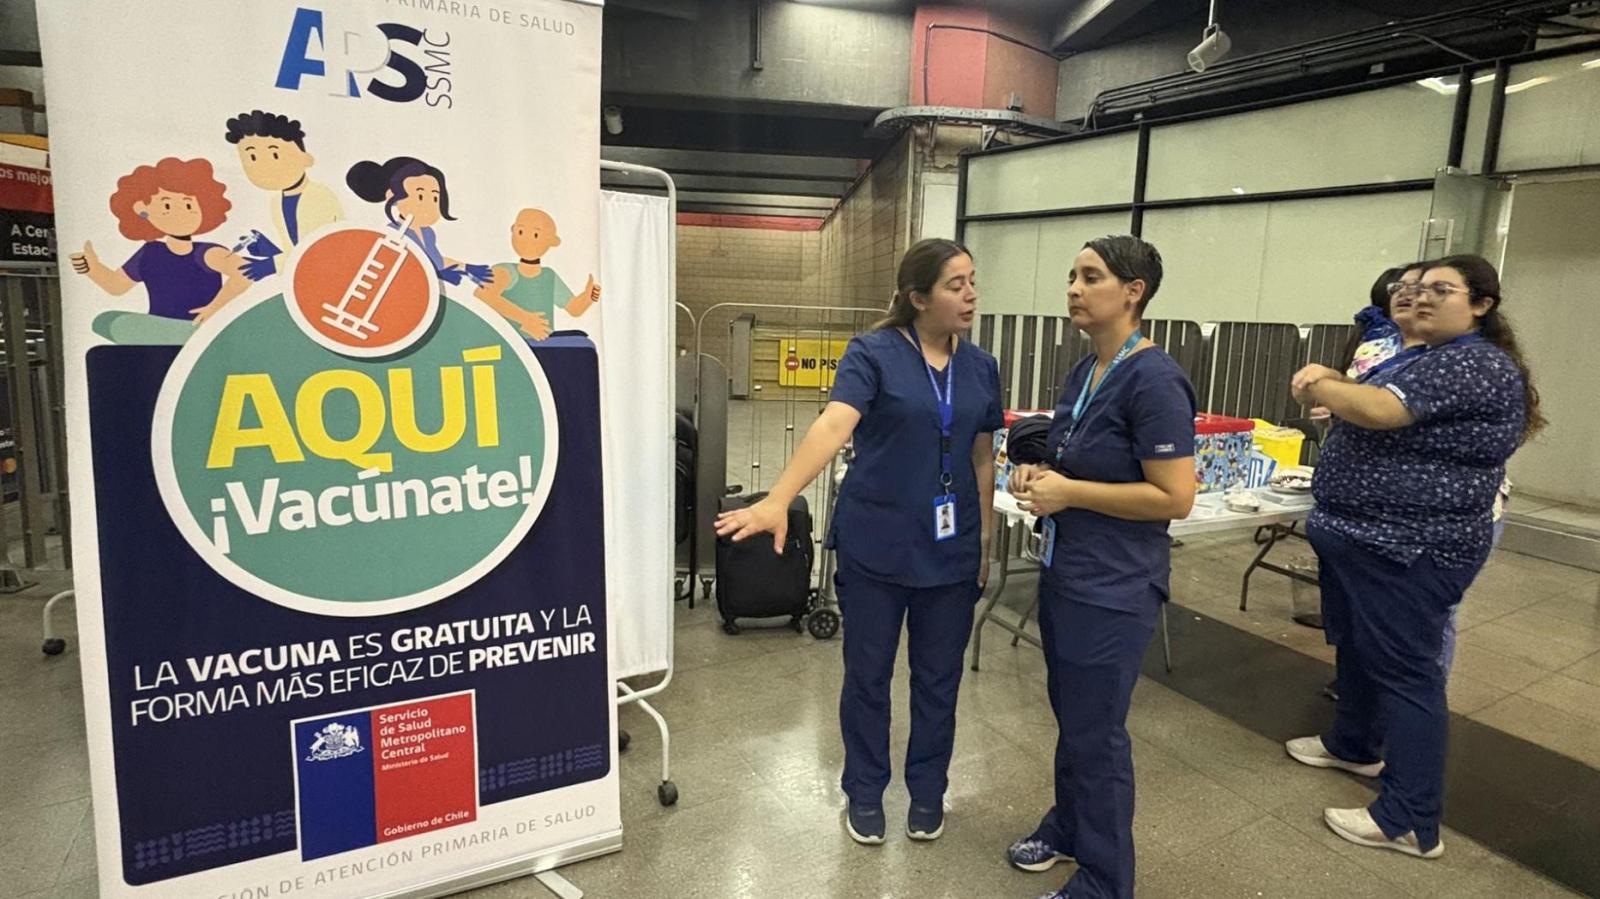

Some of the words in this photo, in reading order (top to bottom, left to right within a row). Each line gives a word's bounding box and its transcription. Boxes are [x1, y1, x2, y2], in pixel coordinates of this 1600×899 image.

[489, 8, 513, 25] DE
[520, 14, 576, 37] SALUD
[274, 7, 428, 103] APS
[423, 28, 452, 109] SSMC
[11, 223, 22, 237] A
[801, 358, 817, 370] NO
[206, 345, 502, 472] AQUÍ
[210, 456, 533, 554] ¡Vacúnate!
[134, 661, 179, 691] LA
[186, 639, 341, 682] VACUNA
[348, 632, 383, 660] ES
[390, 612, 535, 653] GRATUITA
[540, 608, 556, 631] Y
[563, 604, 592, 629] LA
[131, 684, 250, 726] FORMA
[256, 671, 324, 706] MÁS
[330, 657, 424, 694] EFICAZ
[429, 651, 464, 678] DE
[469, 631, 596, 672] PREVENIR
[379, 708, 429, 725] Servicio
[380, 726, 395, 737] de
[398, 718, 432, 733] Salud
[380, 725, 466, 749] Metropolitano
[381, 743, 426, 760] Central
[381, 759, 419, 771] Ministerio
[419, 756, 429, 764] de
[429, 752, 450, 762] Salud
[383, 819, 430, 837] Gobierno
[430, 816, 444, 826] de
[444, 810, 470, 822] Chile
[279, 876, 304, 894] DE
[314, 849, 413, 886] ATENCIÓN
[421, 826, 509, 859] PRIMARIA
[516, 818, 537, 835] DE
[544, 804, 597, 829] SALUD
